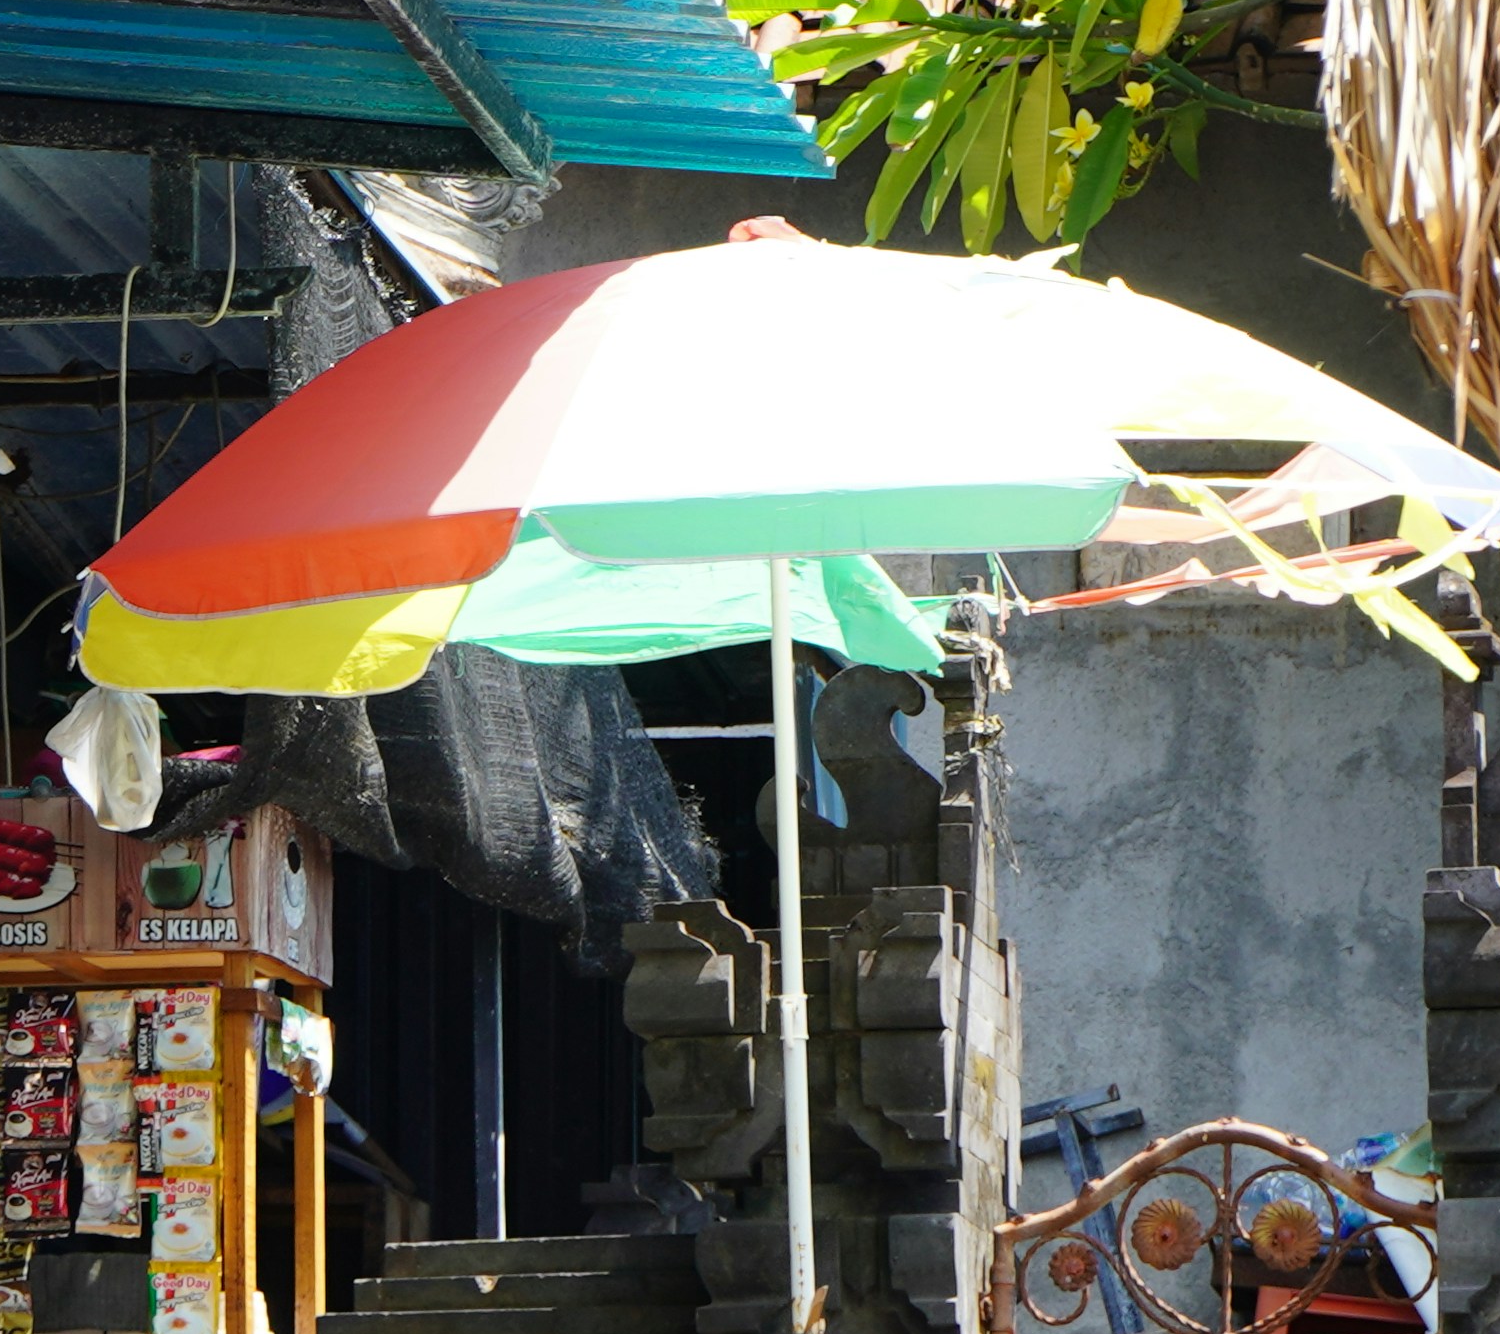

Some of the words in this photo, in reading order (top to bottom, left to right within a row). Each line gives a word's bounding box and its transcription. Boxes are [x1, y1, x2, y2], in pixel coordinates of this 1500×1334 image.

[138, 918, 163, 942] ES
[166, 917, 239, 942] KELAPA
[186, 991, 211, 1005] Day
[186, 1086, 211, 1101] Day
[162, 1181, 185, 1194] ood
[187, 1181, 212, 1197] Day
[152, 1276, 185, 1290] Good
[186, 1276, 211, 1291] Day
